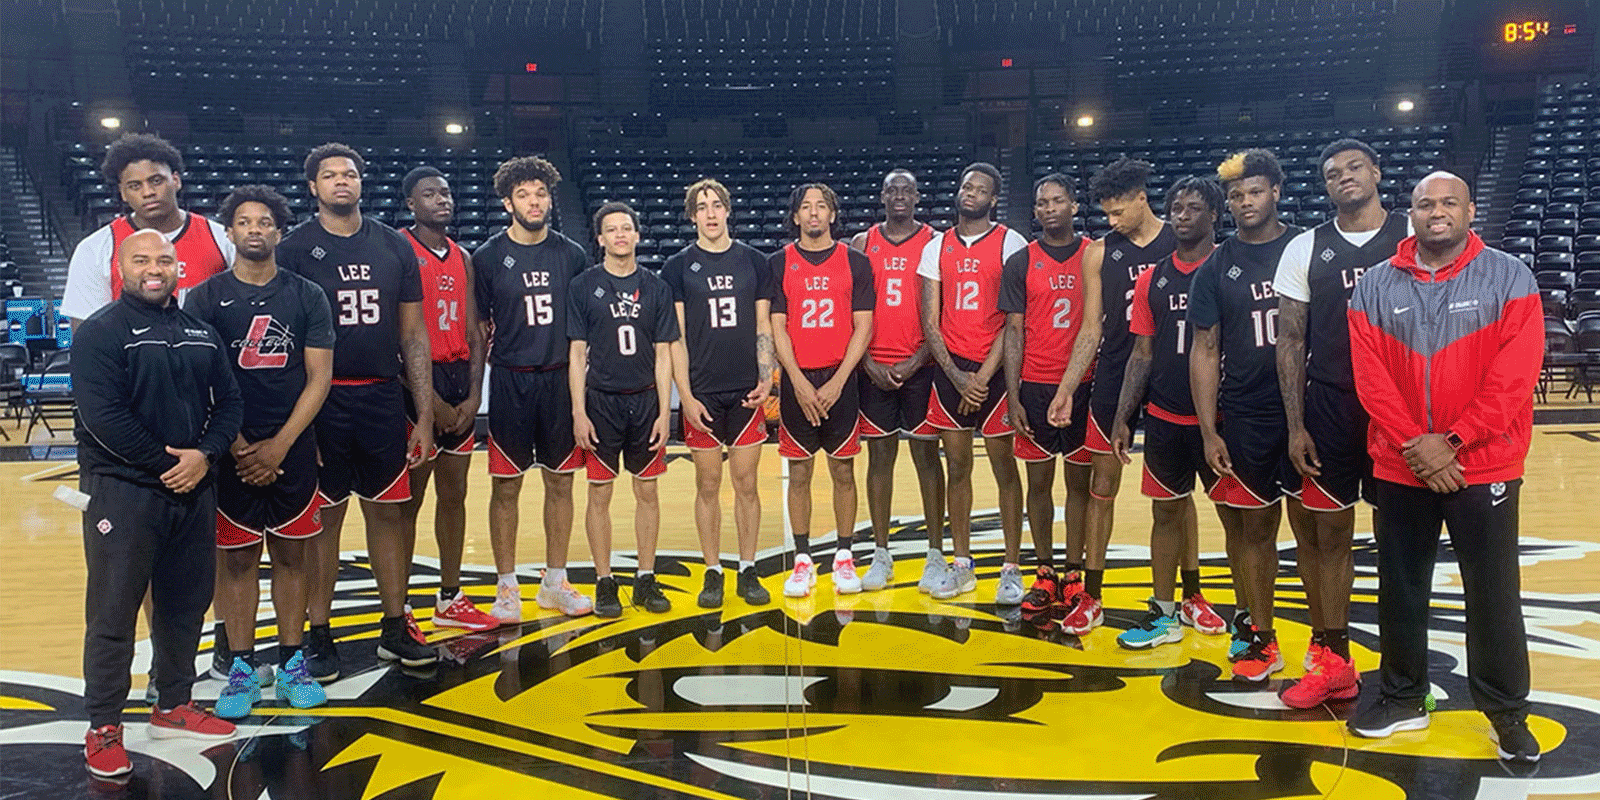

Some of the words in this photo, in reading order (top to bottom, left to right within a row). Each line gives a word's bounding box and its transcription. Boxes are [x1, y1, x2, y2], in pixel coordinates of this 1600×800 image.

[337, 264, 371, 282] LEE
[884, 257, 907, 271] LEE
[956, 258, 980, 273] LEE
[1128, 263, 1157, 281] LE
[436, 275, 455, 291] LEE
[522, 271, 550, 288] LEE
[706, 275, 734, 291] LEE
[804, 276, 830, 291] LEE
[1049, 274, 1075, 290] LEE
[1341, 267, 1364, 289] LE
[886, 278, 902, 306] 5
[955, 280, 980, 310] 12
[1169, 293, 1188, 311] LE
[337, 288, 380, 325] 35
[437, 299, 458, 330] 24
[524, 293, 554, 326] 15
[707, 296, 737, 328] 13
[801, 298, 834, 328] 22
[1053, 297, 1071, 328] 2
[1251, 308, 1279, 347] 10
[617, 324, 637, 356] 0
